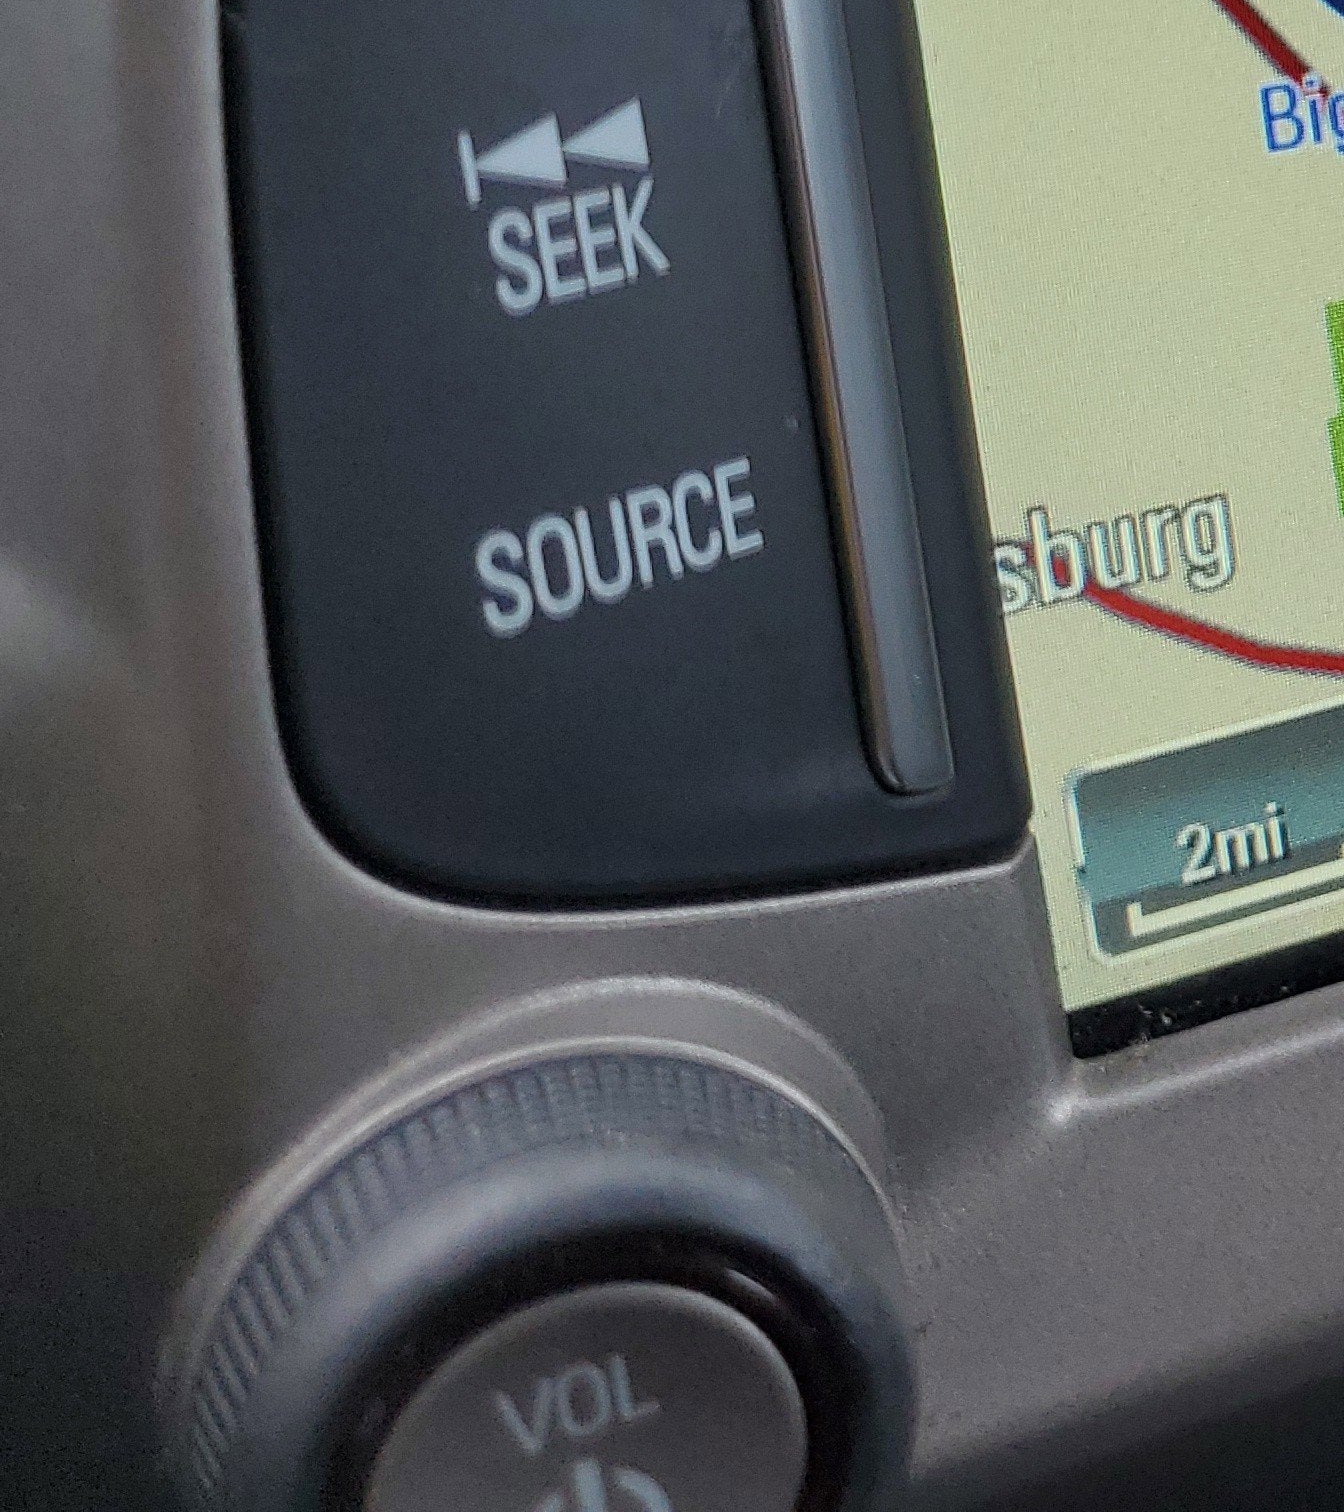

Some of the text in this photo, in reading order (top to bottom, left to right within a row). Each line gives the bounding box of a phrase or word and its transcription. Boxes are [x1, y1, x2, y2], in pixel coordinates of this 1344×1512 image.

[487, 176, 673, 318] SEEK
[475, 455, 767, 639] SOURCE
[994, 492, 1238, 615] sburg
[1175, 800, 1291, 887] 2mi
[499, 1351, 664, 1457] VOL
